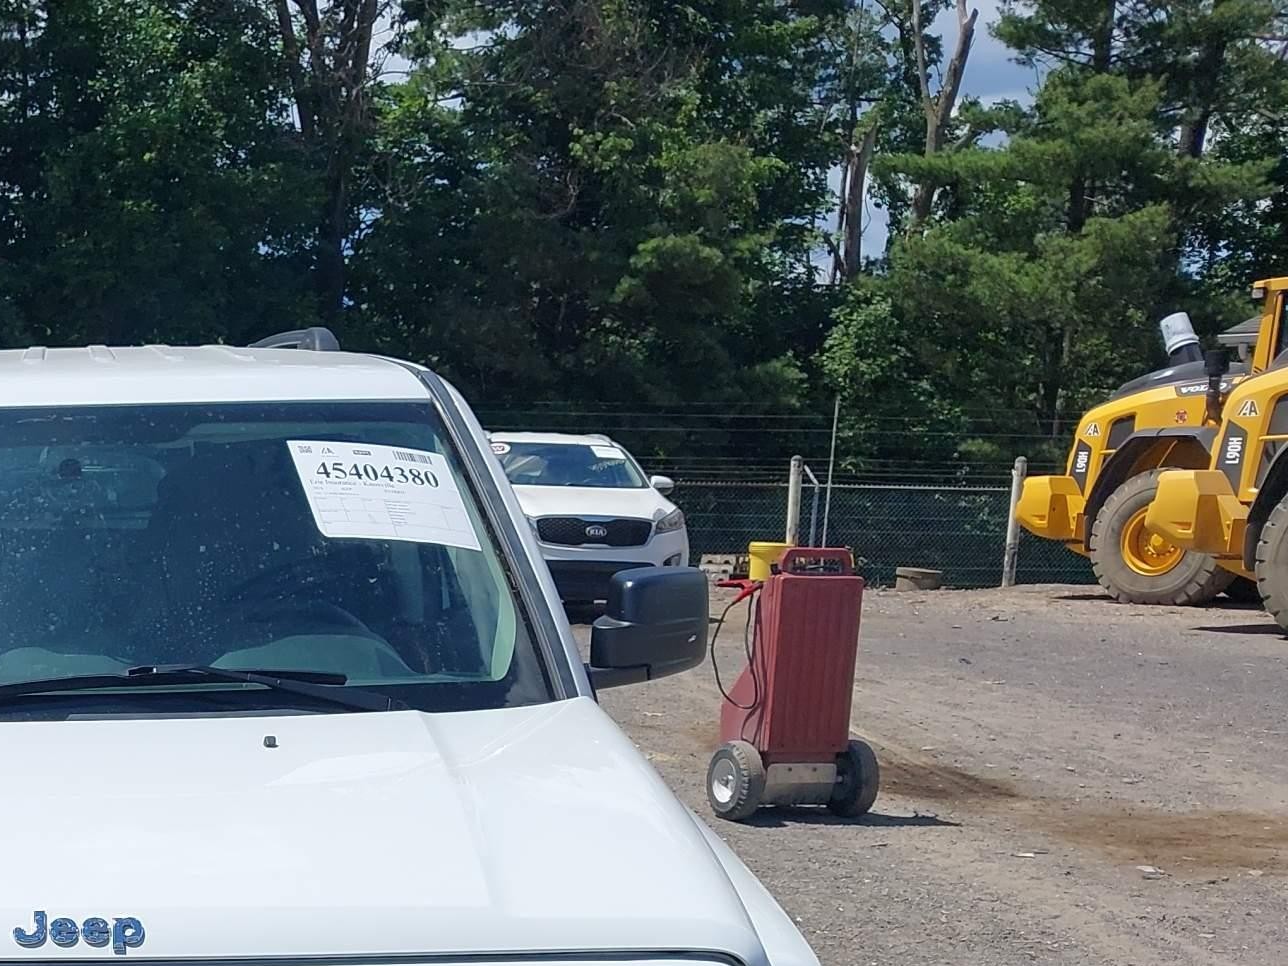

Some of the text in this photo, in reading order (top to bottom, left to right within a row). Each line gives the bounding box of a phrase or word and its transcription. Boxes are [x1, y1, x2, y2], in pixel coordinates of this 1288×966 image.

[1075, 451, 1089, 473] L90H
[1225, 437, 1243, 465] L90H
[316, 462, 440, 488] 45404380
[13, 911, 146, 955] Jeep
